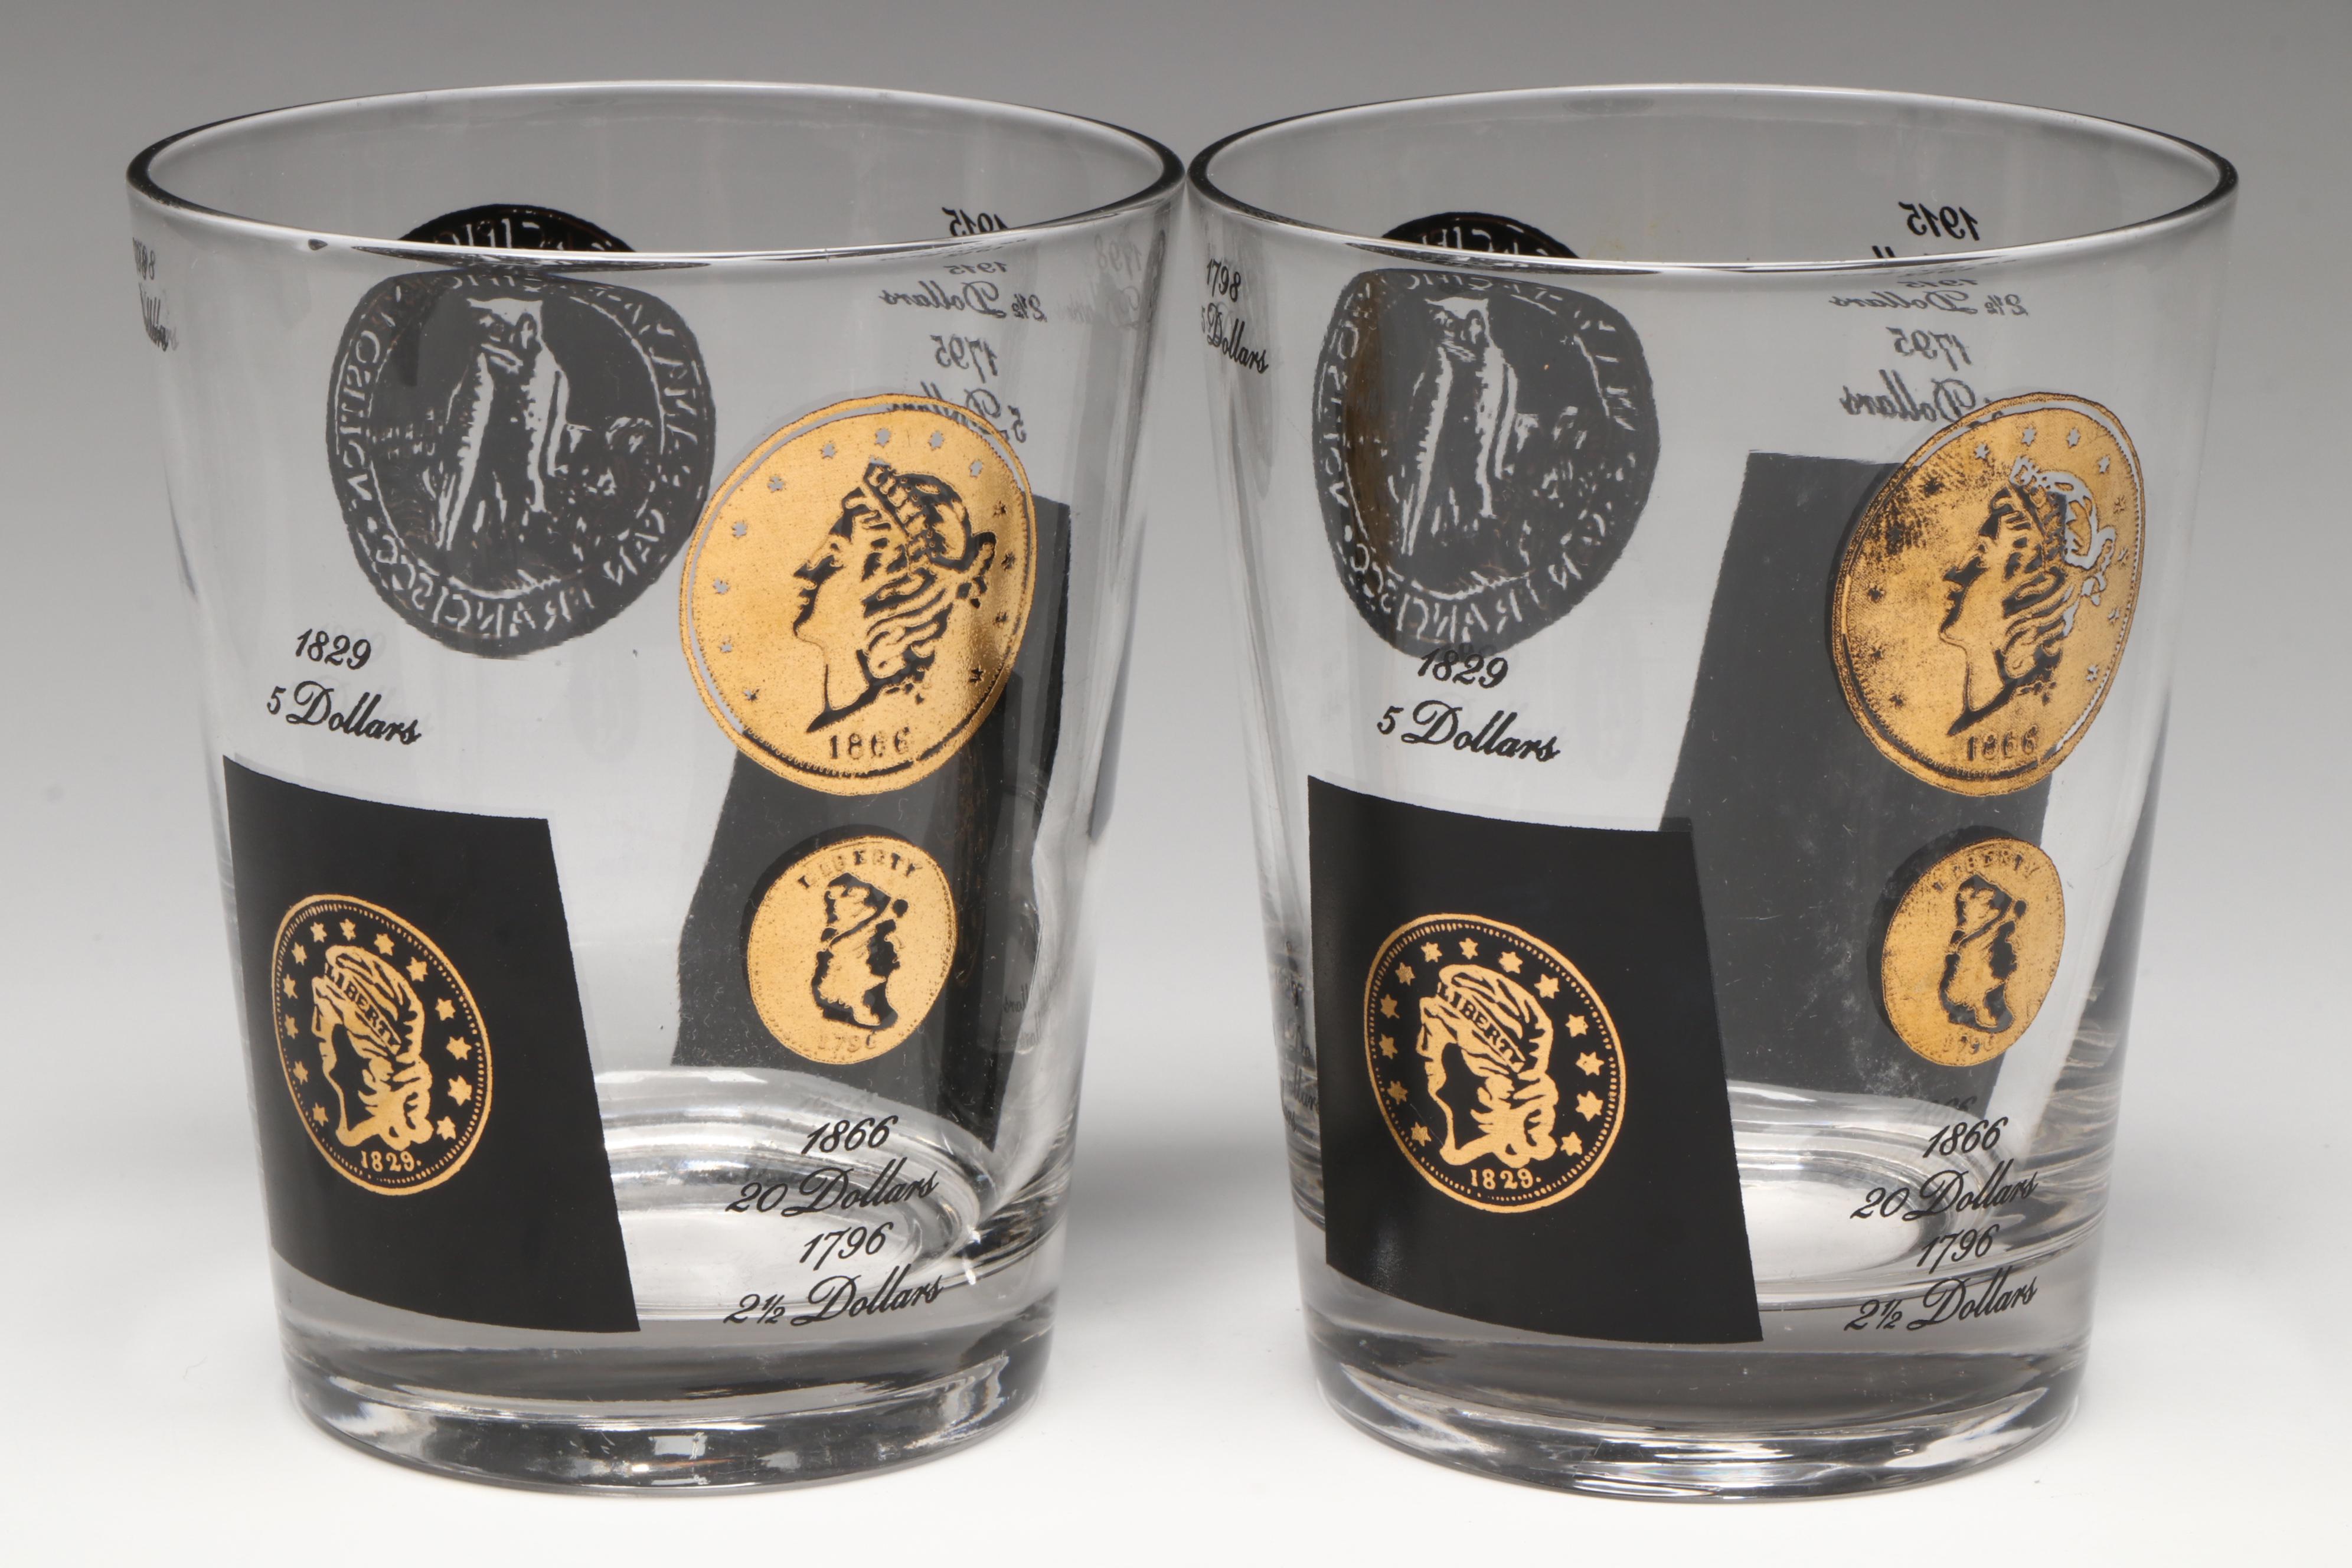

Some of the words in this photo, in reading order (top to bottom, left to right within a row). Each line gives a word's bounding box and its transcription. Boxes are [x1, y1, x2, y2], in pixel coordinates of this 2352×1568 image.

[1207, 257, 1241, 302] 1798
[1207, 302, 1269, 374] Dollars
[295, 628, 371, 670] 1829
[1417, 648, 1508, 688] 1829
[267, 686, 286, 715] 5
[286, 681, 422, 745] Dollars
[1377, 705, 1404, 734] 5
[1401, 700, 1561, 762] Dollars
[797, 849, 923, 890] LIBERTY
[801, 1115, 899, 1155] 1866
[1922, 1116, 2008, 1158] 1866
[725, 1182, 788, 1213] 20
[780, 1157, 940, 1217] Dollars
[1850, 1187, 1910, 1219] 20
[1902, 1158, 2039, 1221] Dollars
[799, 1221, 894, 1271] 1796
[1916, 1224, 2000, 1275] 1796
[790, 1263, 945, 1327] Dollars
[1906, 1266, 2038, 1331] Dollars
